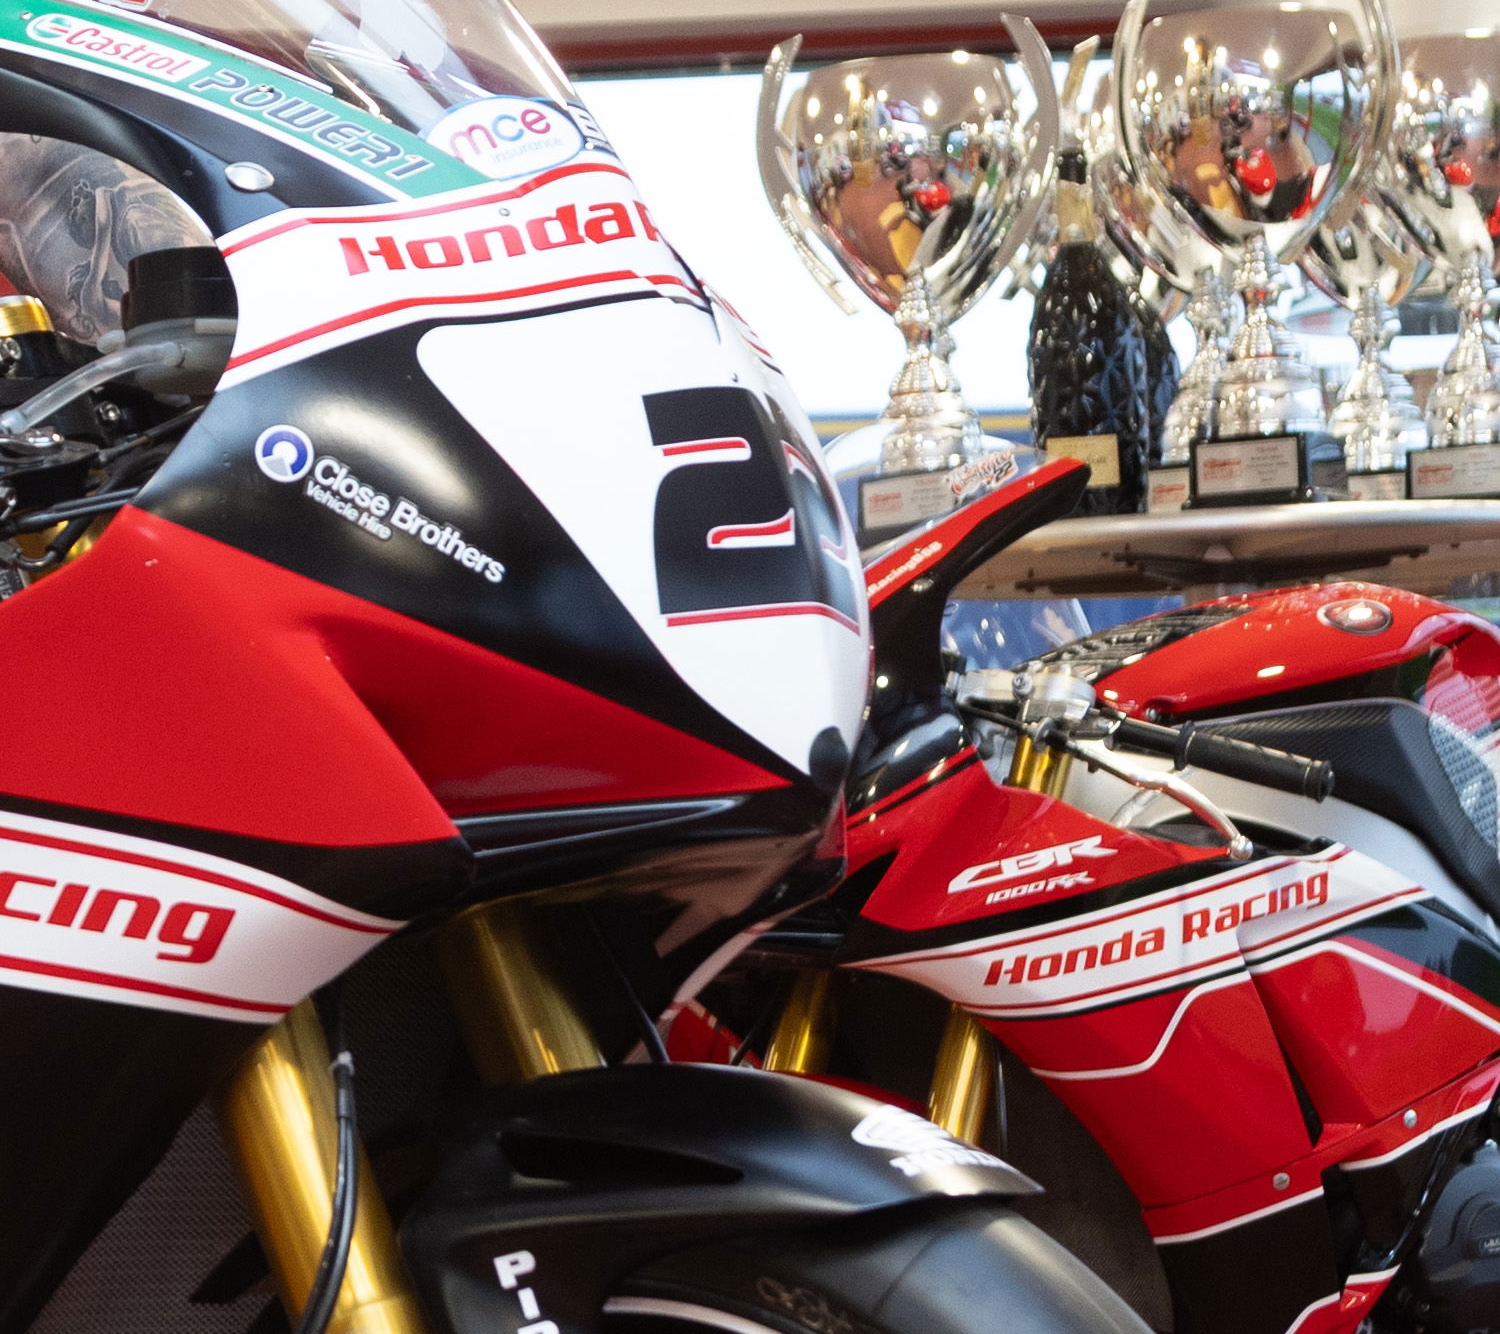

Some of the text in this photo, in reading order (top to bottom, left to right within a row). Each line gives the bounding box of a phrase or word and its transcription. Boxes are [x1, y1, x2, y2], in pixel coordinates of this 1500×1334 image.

[65, 23, 194, 77] Castrol
[189, 67, 436, 182] POWER1
[449, 108, 551, 164] mce
[492, 135, 563, 164] insurance
[339, 200, 636, 278] Honda
[304, 479, 392, 541] Vehicle Hire
[313, 457, 506, 585] Close Brothers
[947, 834, 1120, 894] CBR
[985, 870, 1095, 905] 1000RR
[983, 871, 1330, 986] Honda Racing
